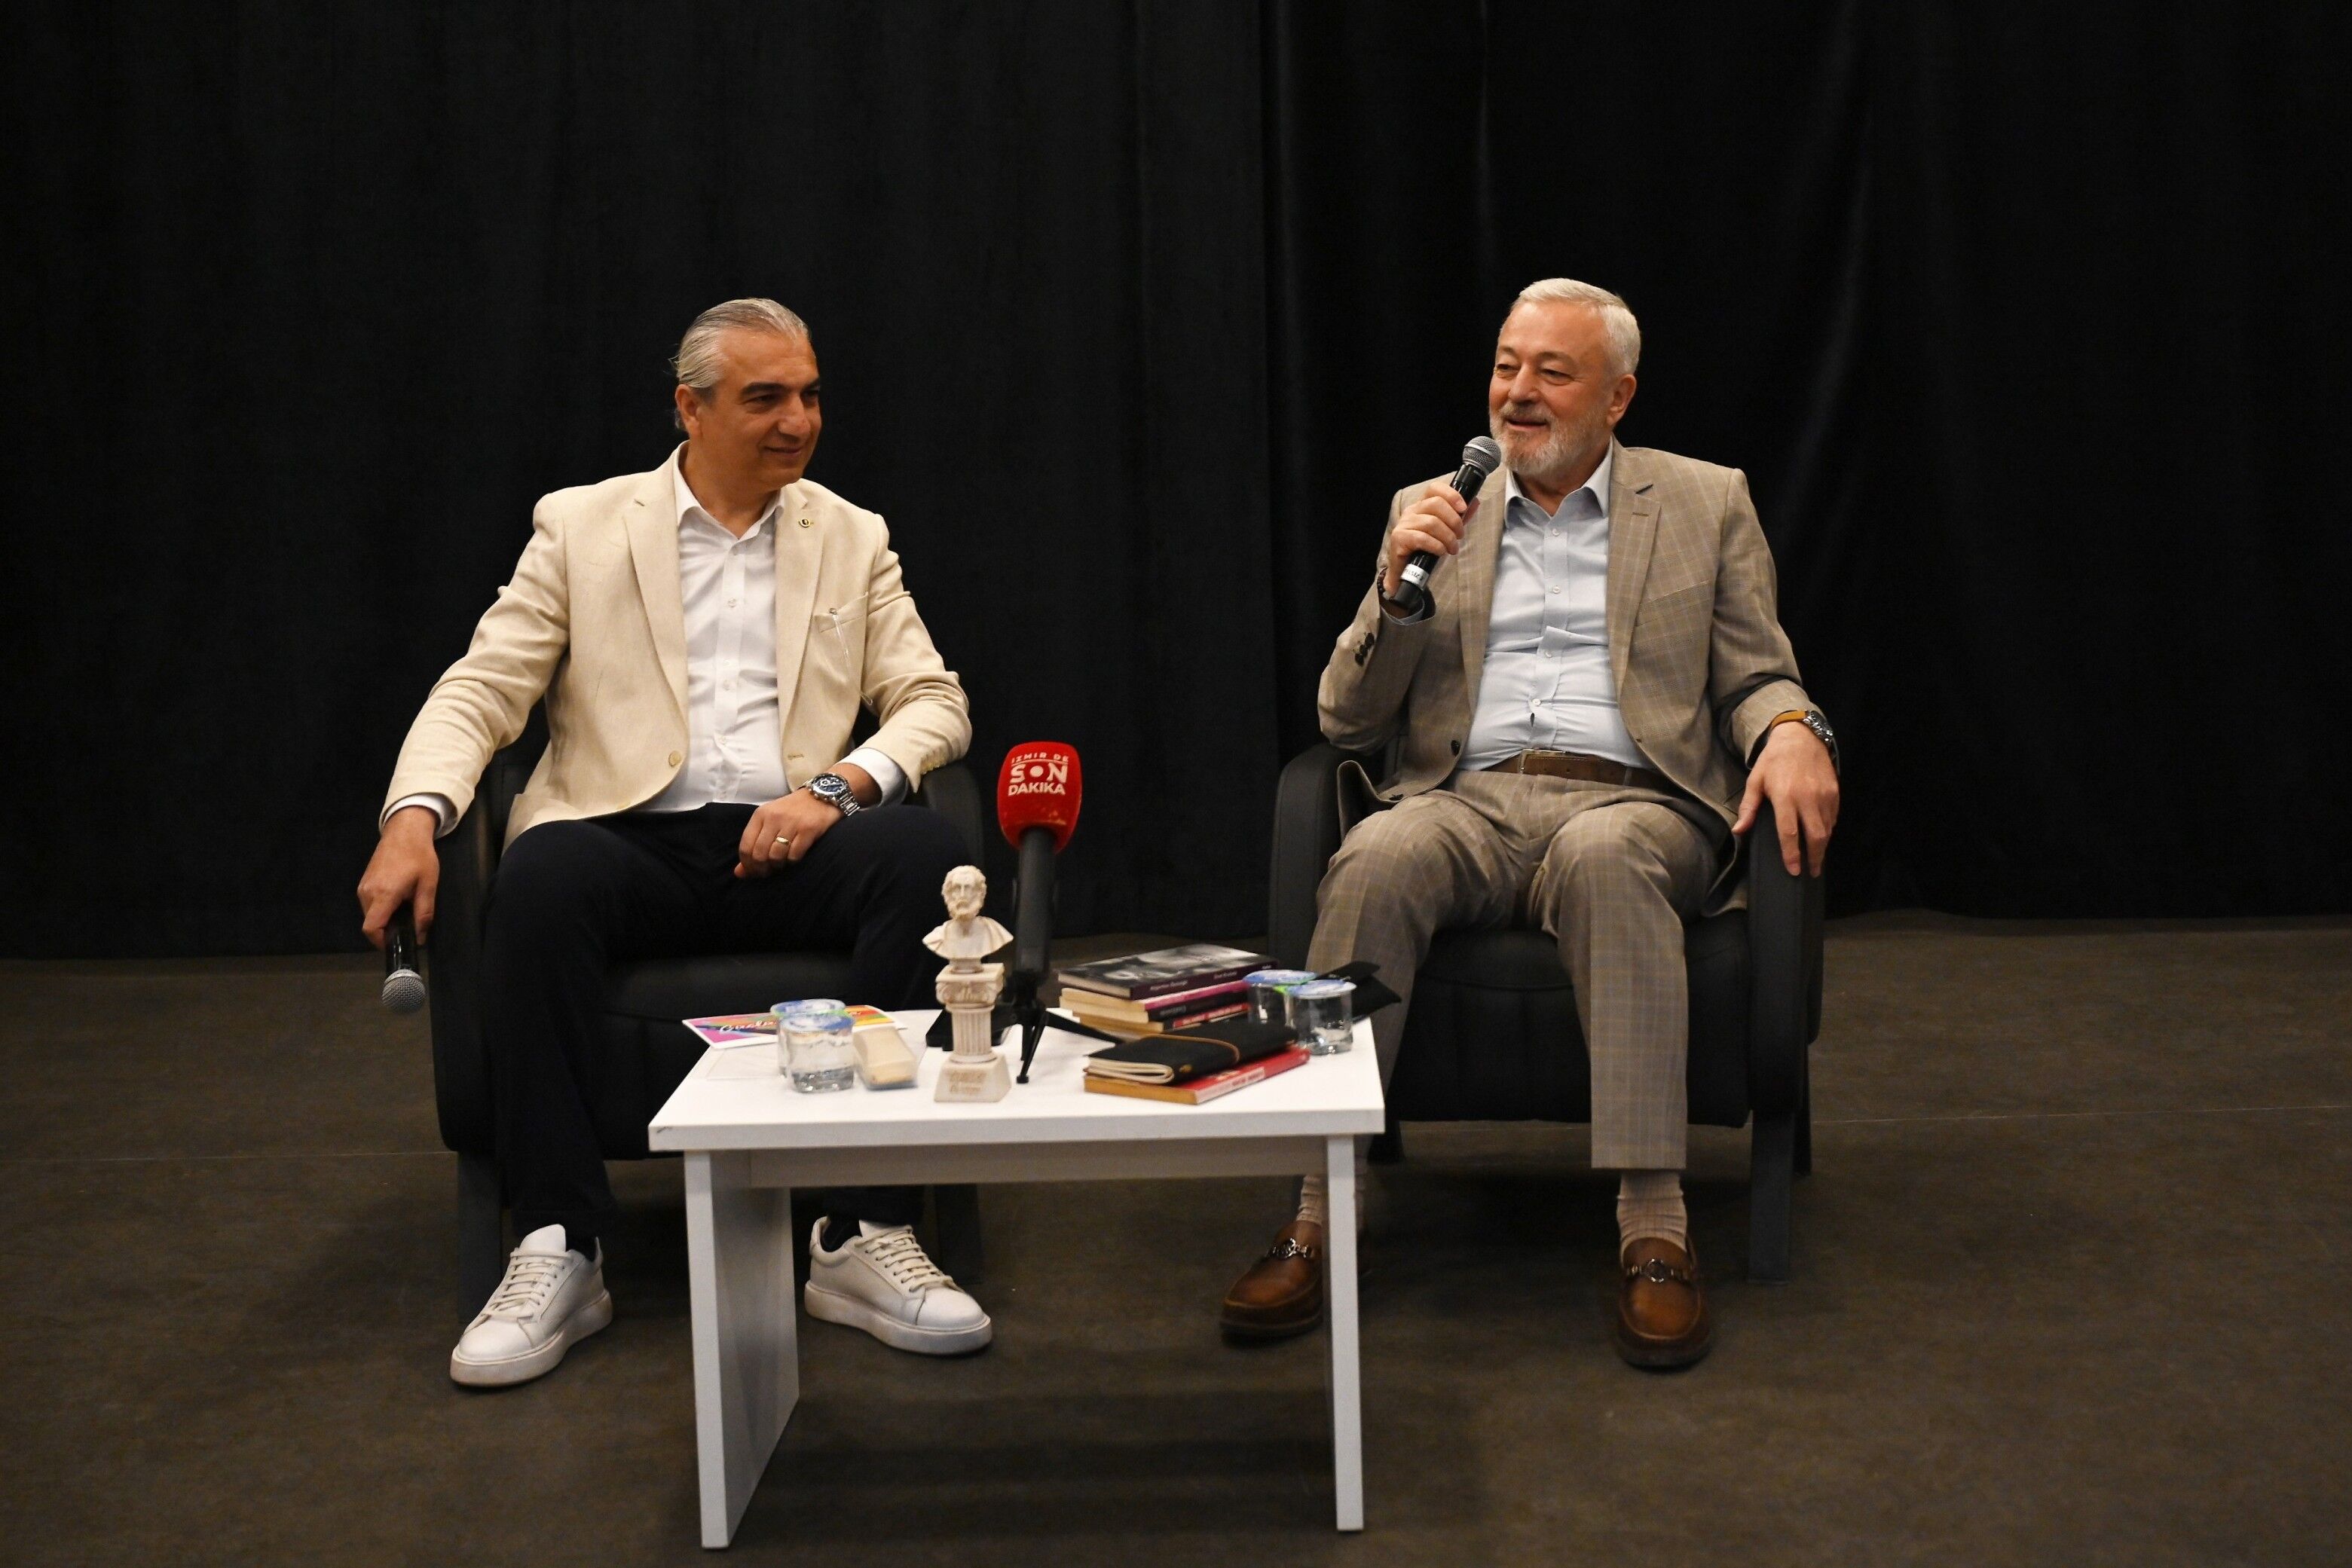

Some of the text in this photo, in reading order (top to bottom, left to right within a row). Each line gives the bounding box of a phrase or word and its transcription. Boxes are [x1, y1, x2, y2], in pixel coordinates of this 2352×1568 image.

[1054, 753, 1069, 762] DE
[1010, 763, 1068, 784] SON
[1008, 782, 1066, 796] DAKIKA
